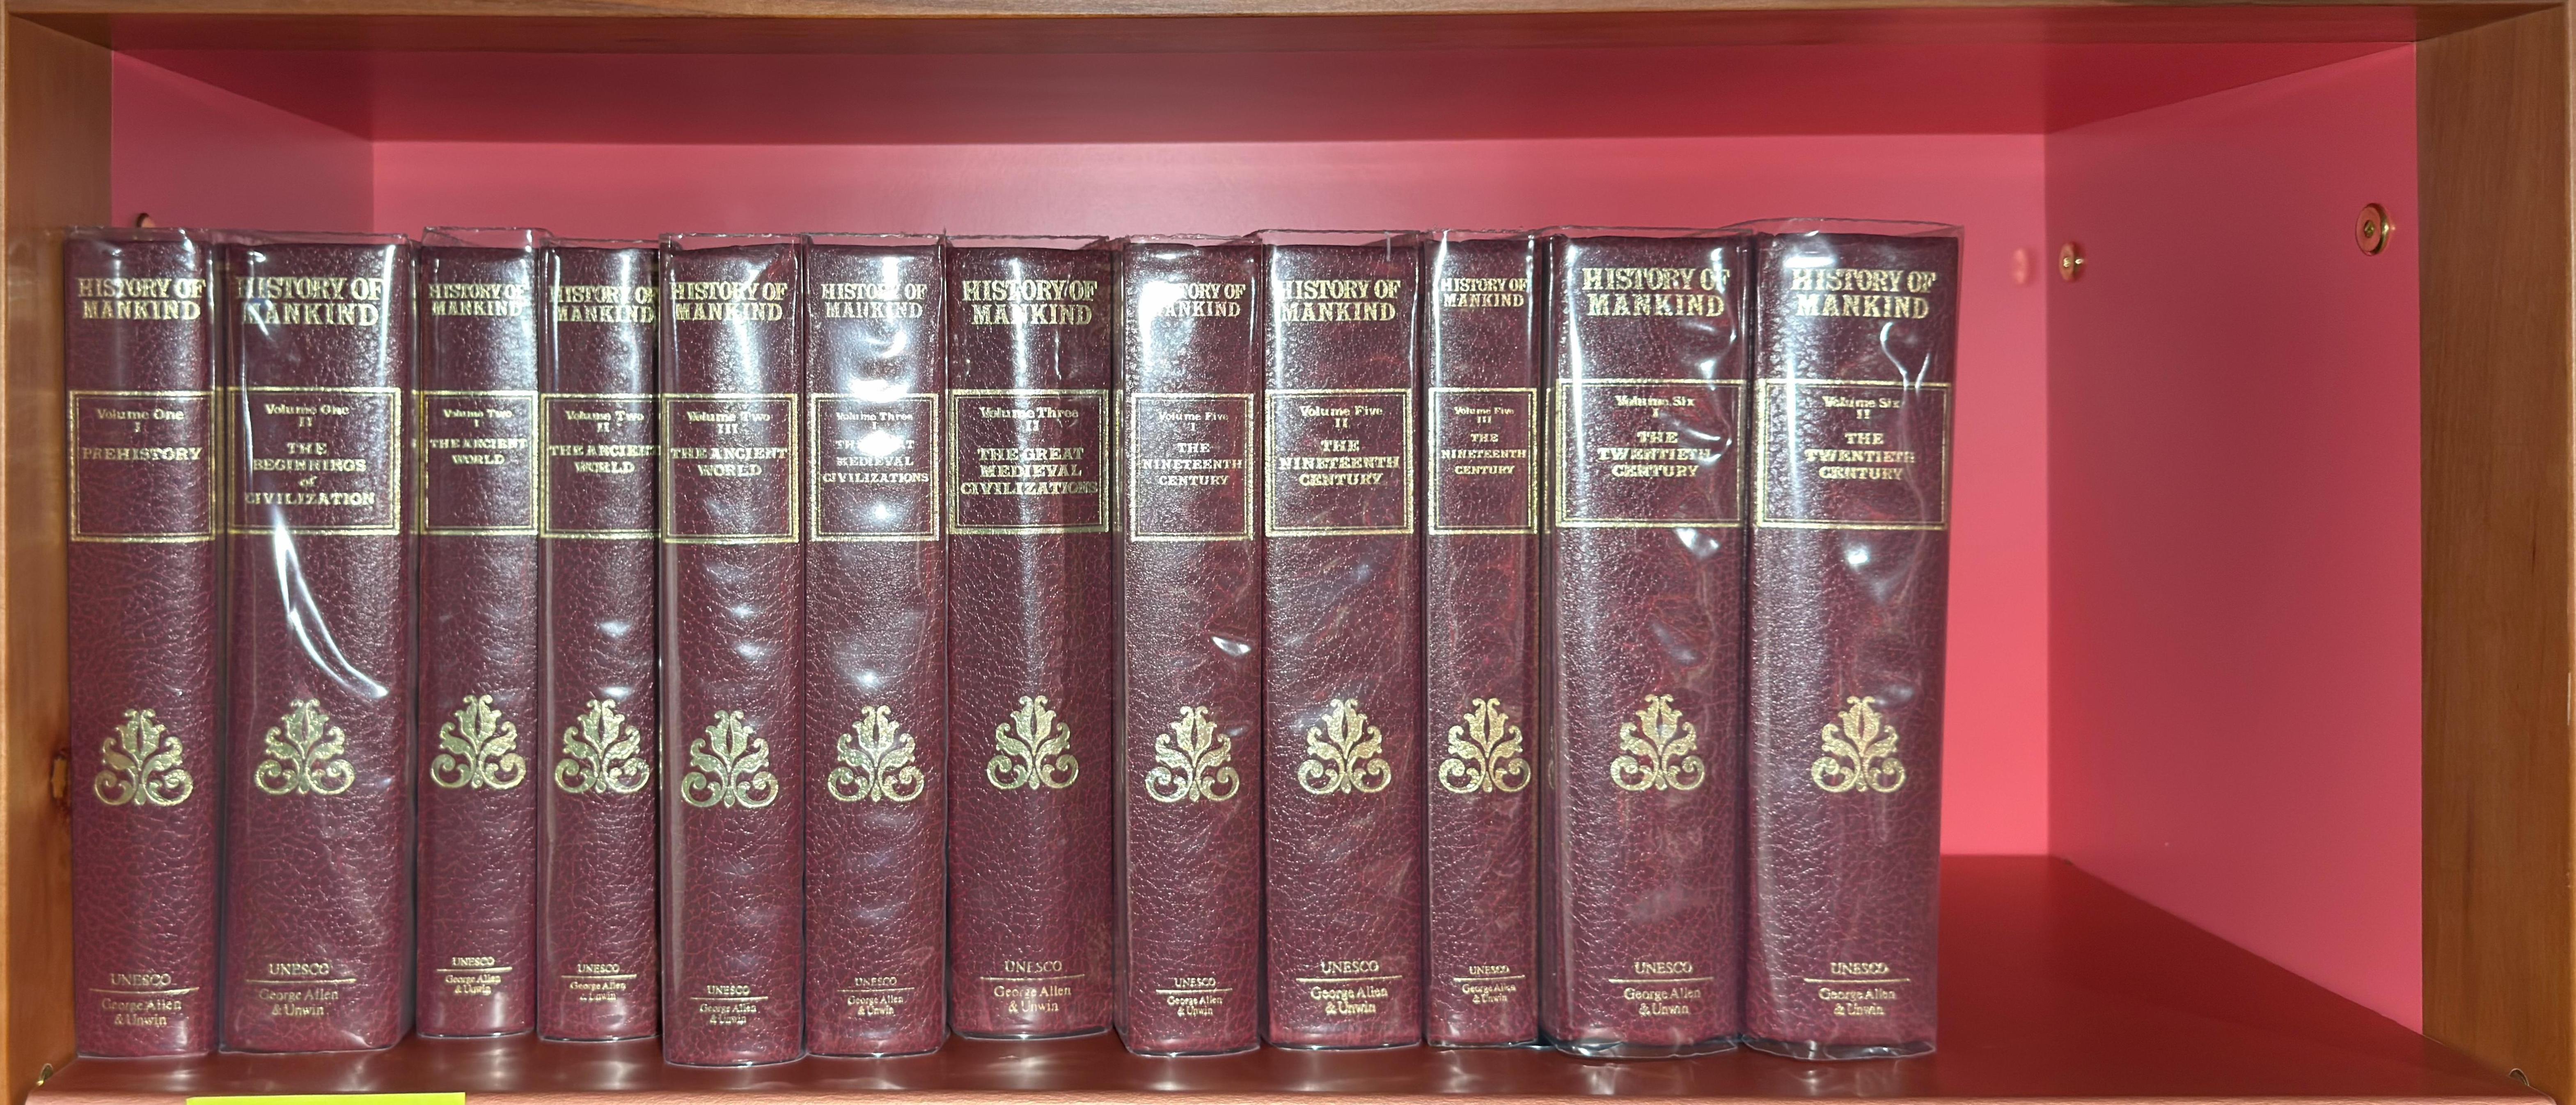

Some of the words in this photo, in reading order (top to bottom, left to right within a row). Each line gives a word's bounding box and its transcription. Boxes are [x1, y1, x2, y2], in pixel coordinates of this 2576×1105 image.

[1441, 278, 1506, 292] HISTORY
[1509, 279, 1527, 291] OF
[1582, 268, 1696, 290] HISTORY
[1700, 269, 1730, 290] OF
[1791, 269, 1904, 292] HISTORY
[1907, 272, 1937, 293] OF
[78, 278, 169, 298] HISTORY
[175, 279, 206, 298] OF
[237, 277, 346, 299] HISTORY
[350, 278, 383, 299] OF
[429, 284, 501, 299] HISTORY
[504, 284, 528, 299] OF
[670, 282, 756, 300] HISTORY
[763, 282, 787, 300] OF
[821, 284, 897, 300] HISTOR
[901, 284, 927, 300] OF
[962, 280, 1065, 302] HISTORY
[1069, 281, 1098, 302] OF
[1224, 284, 1246, 300] OF
[1374, 280, 1400, 299] OF
[1444, 294, 1524, 307] MANKIND
[1587, 294, 1724, 317] MANKIND
[83, 300, 201, 320] MANKIND
[432, 301, 523, 316] MANKIND
[676, 303, 783, 321] MANKIND
[826, 302, 922, 318] MANKIND
[1157, 302, 1241, 317] ANKIND
[1280, 303, 1396, 322] MANKIND
[1796, 295, 1928, 319] MANKIND
[557, 306, 655, 323] MANKIND
[972, 304, 1092, 325] MANKIND
[1615, 396, 1668, 406] Volume
[1673, 396, 1694, 406] Six
[1823, 396, 1876, 407] Volume
[1879, 398, 1900, 408] Six
[97, 409, 149, 420] Volume
[154, 410, 184, 420] One
[265, 404, 316, 416] Volume
[321, 405, 350, 416] One
[443, 409, 484, 418] Volume
[566, 410, 611, 421] Volume
[618, 410, 644, 421] Two
[979, 407, 1035, 419] Volume
[1038, 407, 1078, 419] Three
[1299, 406, 1350, 416] Volume
[1355, 406, 1382, 416] Five
[1454, 407, 1491, 415] Volume
[1652, 408, 1659, 417] I
[1856, 409, 1870, 419] II
[299, 417, 313, 427] II
[687, 412, 736, 422] Volume
[740, 412, 770, 422] Two
[837, 412, 876, 421] Volume
[879, 412, 913, 420] Three
[1158, 412, 1201, 422] Volume
[1204, 412, 1228, 421] Five
[134, 422, 142, 432] I
[474, 419, 480, 428] I
[597, 423, 610, 432] II
[718, 423, 738, 434] III
[1027, 421, 1039, 432] II
[1190, 423, 1196, 431] I
[1335, 418, 1348, 428] II
[1471, 434, 1498, 442] THE
[1637, 432, 1678, 443] THE
[1845, 432, 1884, 445] THE
[287, 443, 327, 455] THE
[429, 439, 459, 449] THE
[463, 439, 528, 449] ANCIENT
[835, 440, 860, 449] TH
[1178, 443, 1210, 453] THE
[1320, 440, 1359, 451] THE
[83, 447, 202, 460] PREHISTORY
[549, 445, 584, 456] THE
[671, 448, 707, 459] THE
[710, 448, 788, 459] ANCIENT
[977, 448, 1018, 461] THE
[1026, 448, 1084, 460] GREAT
[1441, 450, 1526, 458] NINETEENTH
[253, 459, 367, 471] BEGINNINGS
[451, 454, 505, 465] WORLD
[837, 457, 914, 466] MEDIEVAL
[1143, 460, 1242, 469] NINETEENTH
[1279, 457, 1399, 469] NINETEENTH
[575, 462, 635, 473] WORLD
[698, 464, 762, 476] WORLD
[980, 465, 1082, 478] MEDIEVAL
[1455, 466, 1515, 474] CENTURY
[1612, 465, 1699, 477] CENTURY
[1819, 466, 1903, 480] CENTURY
[298, 476, 316, 487] of
[823, 473, 929, 483] CIVILIZATIONS
[1158, 475, 1229, 485] CENTURY
[1299, 474, 1383, 486] CENTURY
[960, 482, 1098, 494] CIVILIZATIONS
[245, 492, 375, 505] CIVILIZATION
[452, 957, 495, 967] UNESCO
[1004, 961, 1062, 973] UNESCO
[1321, 961, 1379, 973] UNESCO
[1635, 962, 1693, 974] UNESCO
[269, 963, 330, 976] UNESCO
[578, 964, 619, 974] UNESCO
[1469, 965, 1509, 975] UNESCO
[1831, 962, 1888, 975] UNESCO
[111, 973, 172, 986] UNESCO
[855, 977, 897, 986] UNESCO
[1175, 978, 1216, 987] UNESCO
[259, 989, 302, 1002] George
[305, 989, 339, 1001] Allen
[707, 986, 749, 996] UNESCO
[994, 986, 1037, 998] George
[1040, 986, 1071, 997] Allen
[1311, 987, 1354, 1000] George
[1357, 987, 1388, 998] Allen
[1624, 988, 1667, 1000] George
[1668, 988, 1701, 999] Allen
[1819, 988, 1864, 1001] George
[1866, 988, 1896, 1000] Allen
[101, 998, 144, 1012] George
[145, 999, 181, 1011] Allen
[847, 995, 878, 1006] George
[1008, 1001, 1019, 1012] &
[1021, 1000, 1059, 1012] Unwin
[1167, 996, 1198, 1005] George
[1199, 996, 1222, 1005] Allen
[272, 1005, 282, 1016] &
[284, 1004, 325, 1016] Unwin
[1178, 1007, 1185, 1016] &
[1186, 1007, 1213, 1016] Unwin
[1325, 1002, 1336, 1014] &
[1337, 1001, 1376, 1013] Unwin
[1638, 1004, 1649, 1016] &
[1651, 1003, 1689, 1015] Unwin
[1834, 1005, 1844, 1016] &
[1845, 1003, 1884, 1016] Unwin
[115, 1015, 123, 1025] &
[124, 1014, 166, 1026] Unwin
